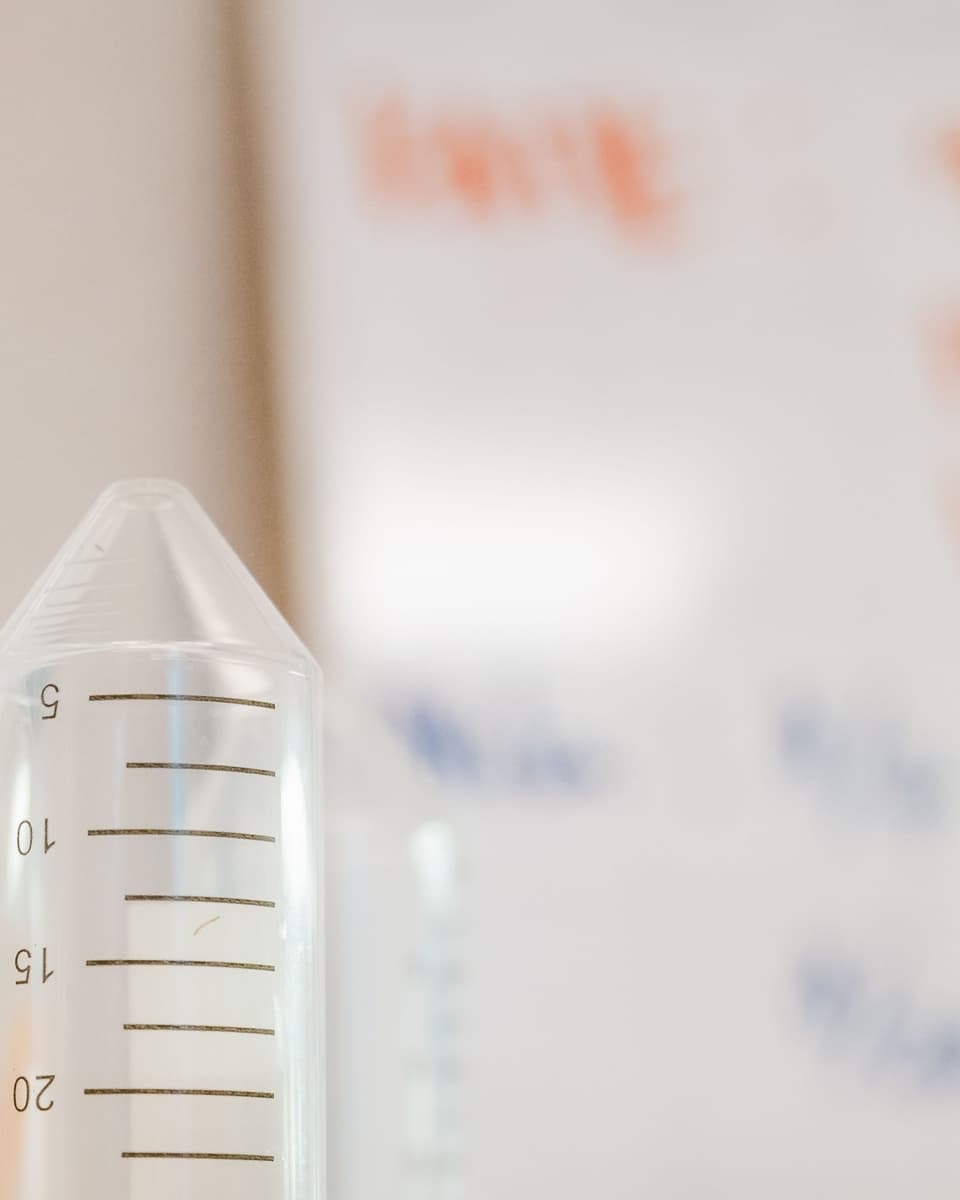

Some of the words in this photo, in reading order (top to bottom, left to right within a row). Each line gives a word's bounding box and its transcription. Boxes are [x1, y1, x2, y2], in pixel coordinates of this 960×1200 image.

[41, 683, 60, 719] 5
[17, 818, 55, 856] 10
[14, 947, 54, 985] 15
[13, 1075, 55, 1112] 20
